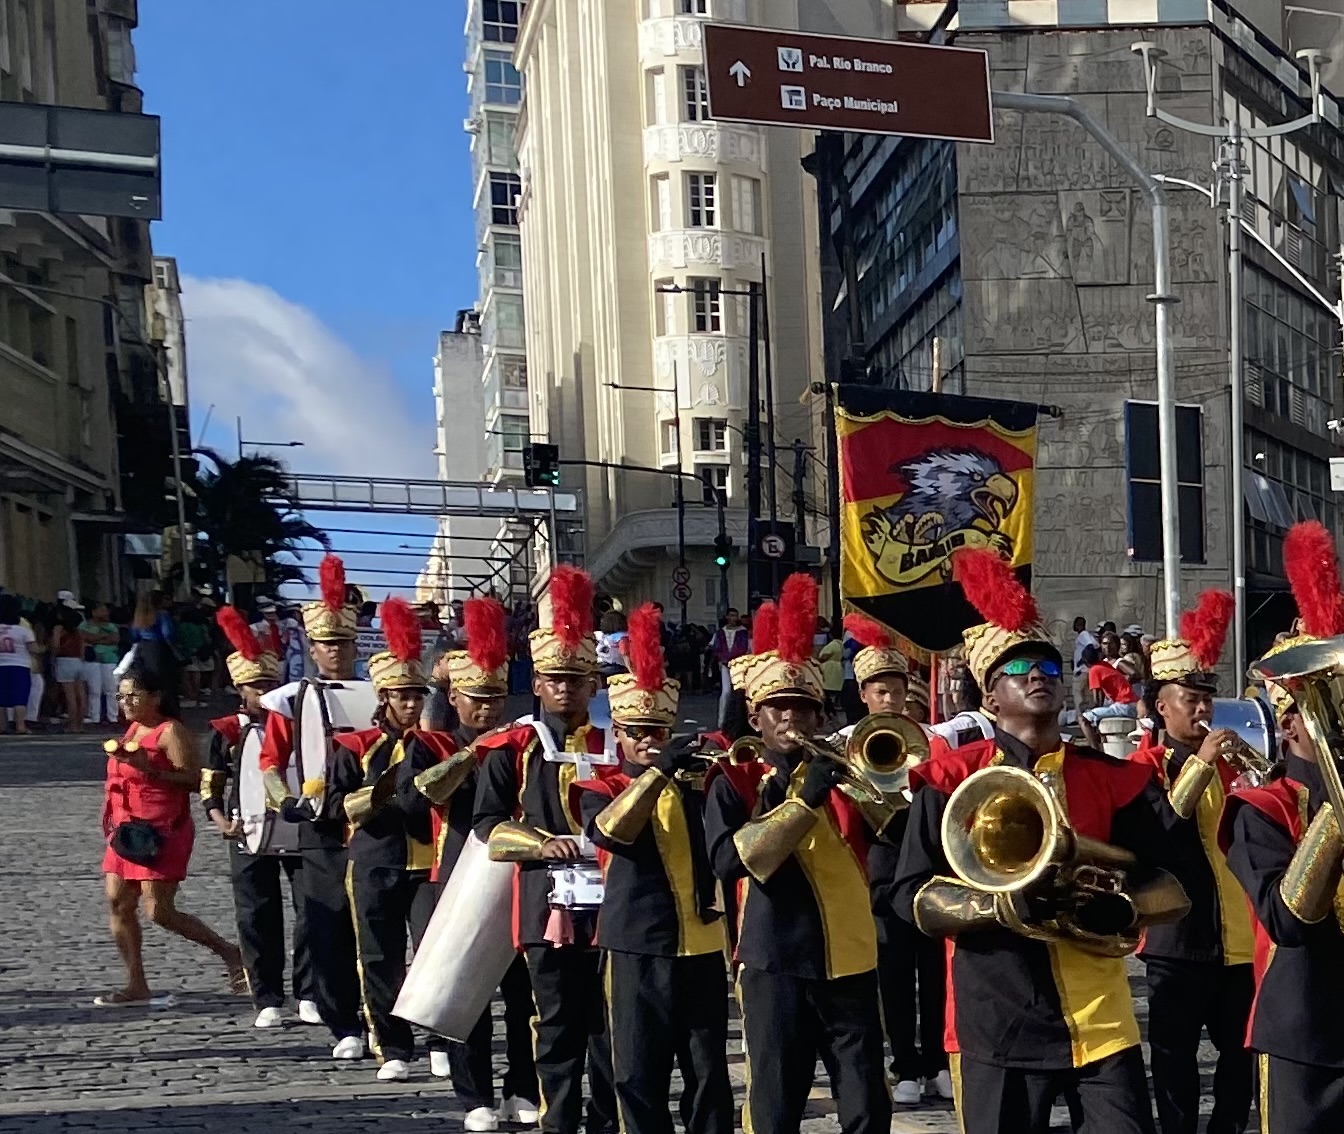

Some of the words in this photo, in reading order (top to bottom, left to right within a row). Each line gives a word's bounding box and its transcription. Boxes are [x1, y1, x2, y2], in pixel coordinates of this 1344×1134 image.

[809, 54, 830, 68] Pal.
[832, 56, 852, 70] Rio
[854, 58, 892, 73] Branco
[812, 93, 841, 110] Paço
[843, 96, 898, 114] Municipal
